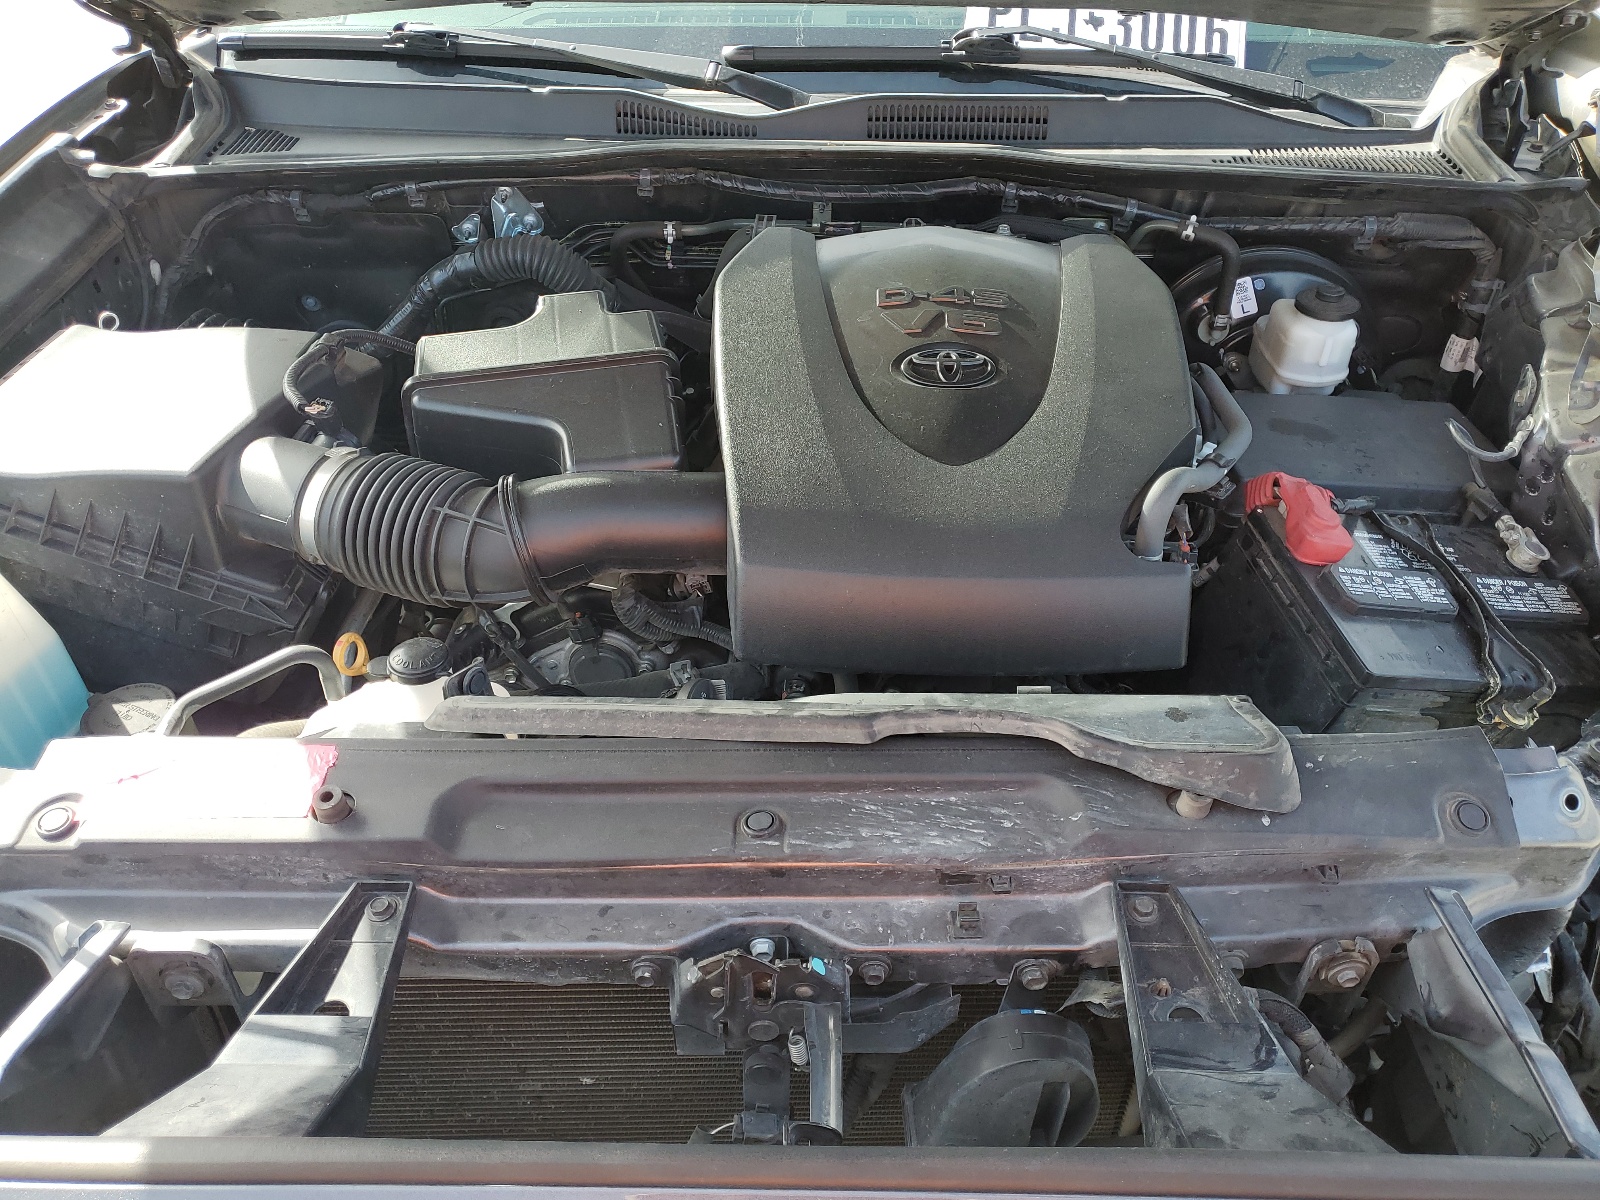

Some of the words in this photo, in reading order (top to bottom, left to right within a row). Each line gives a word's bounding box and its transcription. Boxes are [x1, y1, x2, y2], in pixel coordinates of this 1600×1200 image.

[1240, 304, 1251, 315] L
[880, 308, 1002, 336] V6
[392, 651, 438, 670] COOLANT
